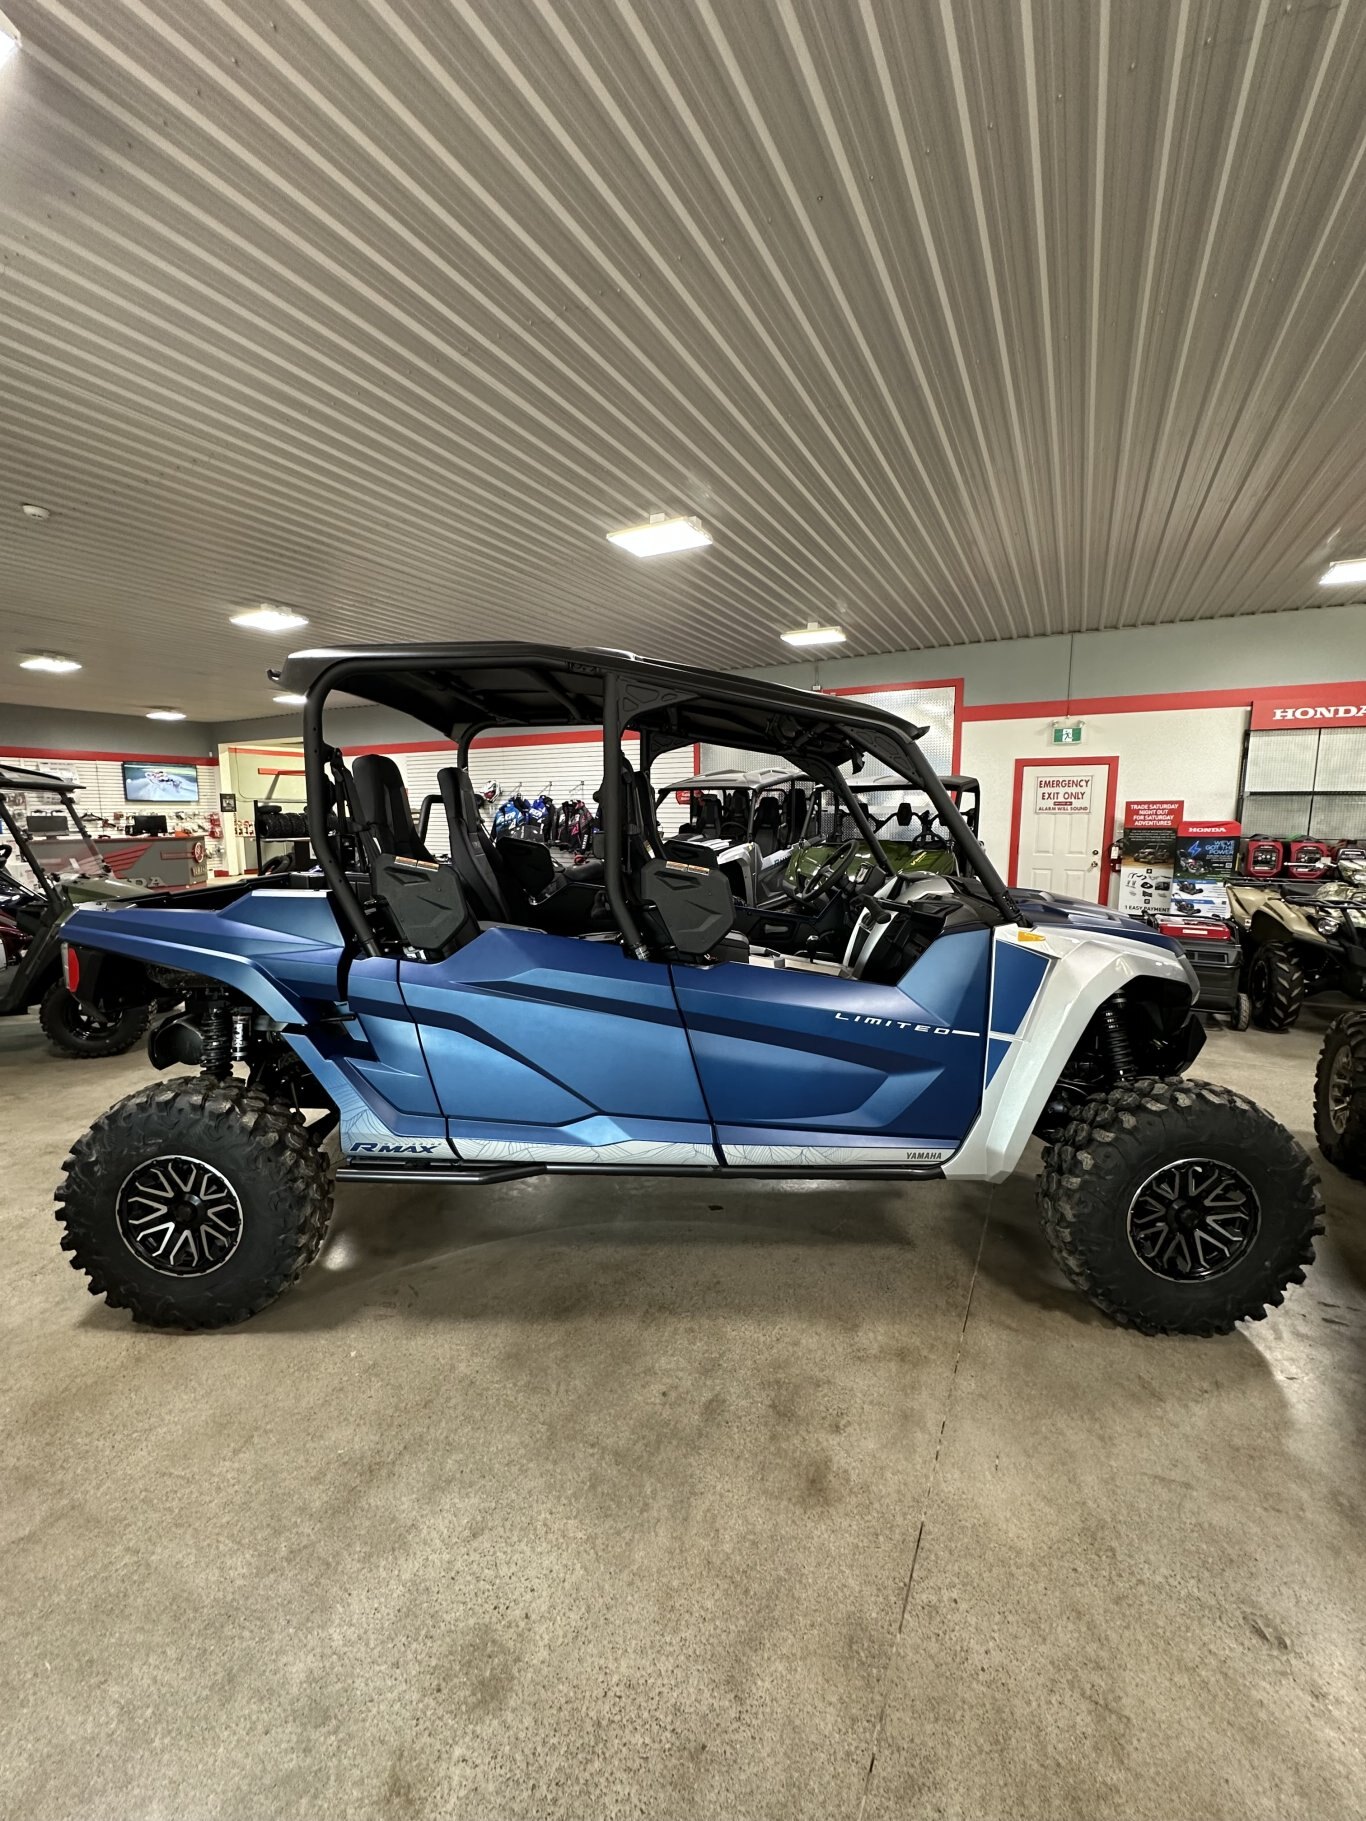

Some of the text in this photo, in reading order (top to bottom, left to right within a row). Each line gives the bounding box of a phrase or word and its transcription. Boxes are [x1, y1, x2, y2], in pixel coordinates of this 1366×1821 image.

[1039, 779, 1090, 788] EMERGENCY
[1041, 791, 1085, 800] EXIT ONLY
[835, 1012, 950, 1035] LIMITED
[906, 1152, 942, 1160] YAMAHA
